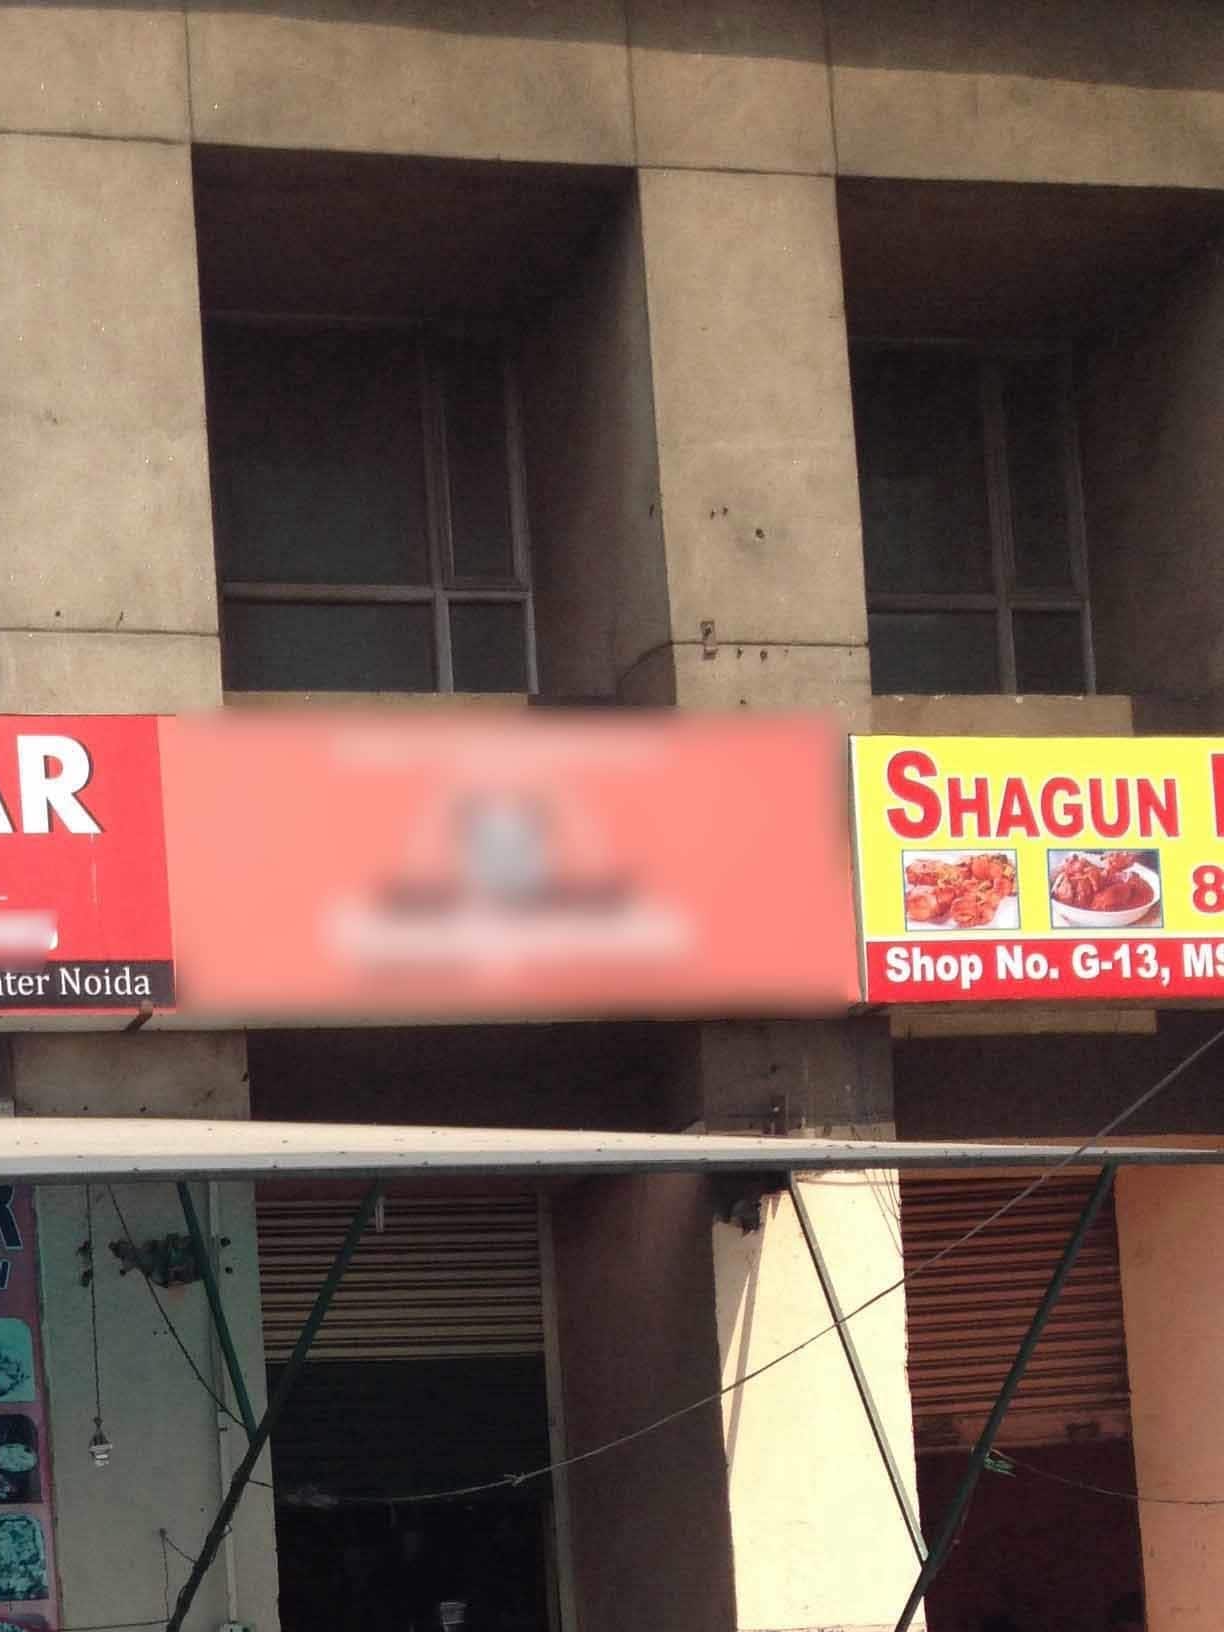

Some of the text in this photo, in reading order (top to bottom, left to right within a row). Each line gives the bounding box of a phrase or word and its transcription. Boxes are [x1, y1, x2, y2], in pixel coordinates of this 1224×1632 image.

[887, 750, 1180, 839] SHAGUN
[59, 966, 152, 997] Noida
[886, 946, 983, 989] Shop
[995, 945, 1059, 981] No.
[1072, 943, 1171, 986] G-13,
